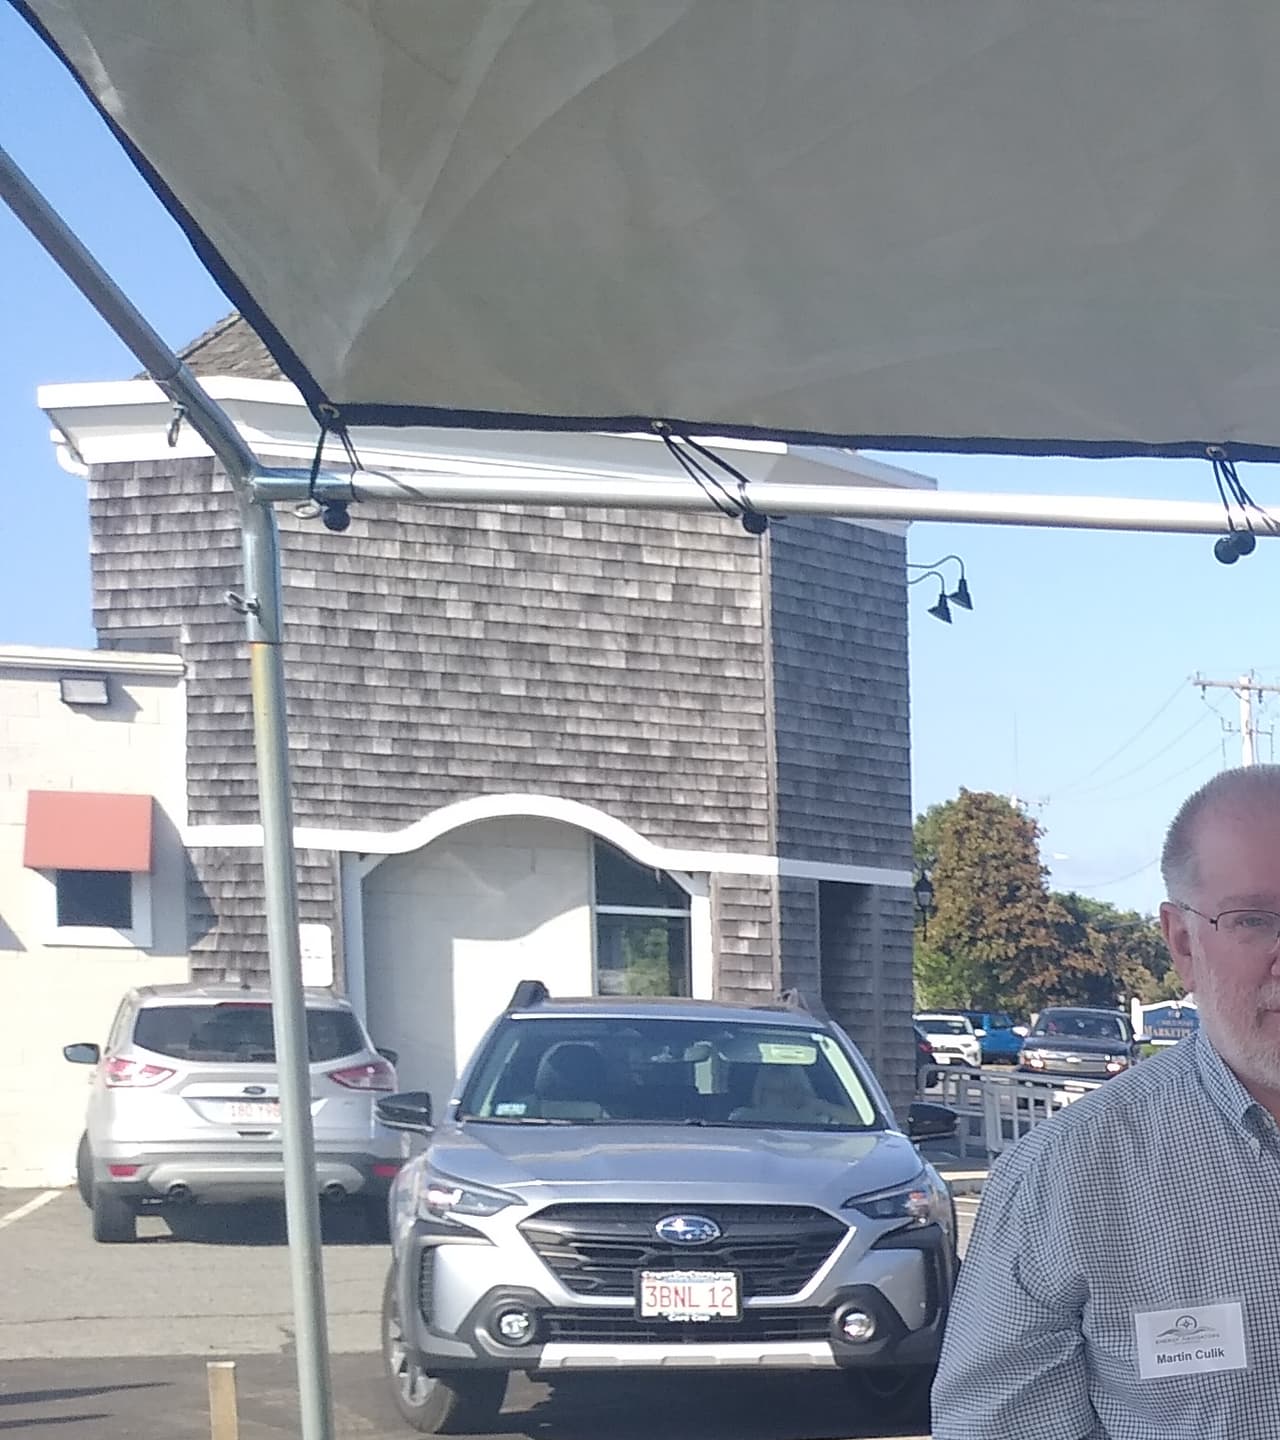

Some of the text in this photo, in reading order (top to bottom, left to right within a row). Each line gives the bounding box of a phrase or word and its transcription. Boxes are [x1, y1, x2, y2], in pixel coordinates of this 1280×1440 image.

[645, 1286, 733, 1308] 3BNL 12
[1157, 1348, 1224, 1364] Martin Culik
